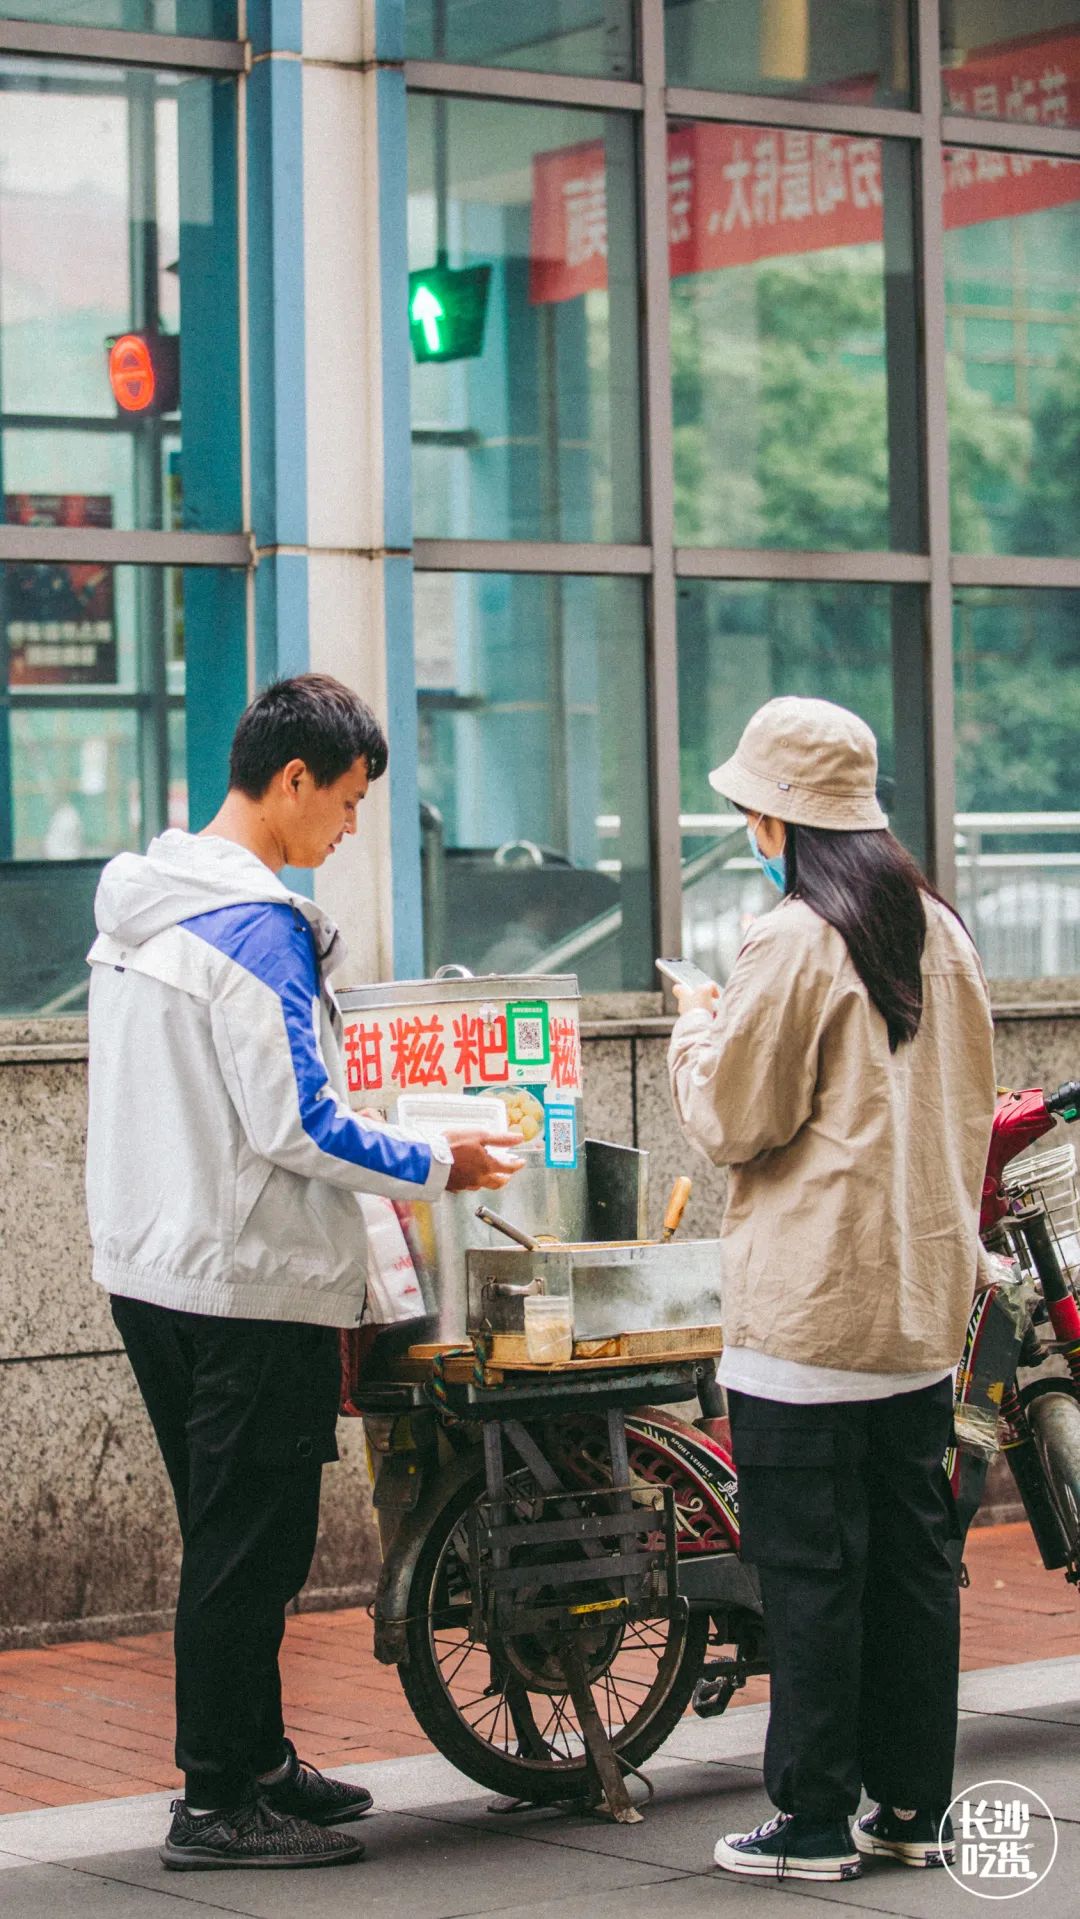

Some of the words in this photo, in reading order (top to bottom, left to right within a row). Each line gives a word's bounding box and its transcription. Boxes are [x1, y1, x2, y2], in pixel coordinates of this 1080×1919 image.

[344, 1014, 509, 1092] 甜糍粑
[671, 1437, 691, 1456] SPORT
